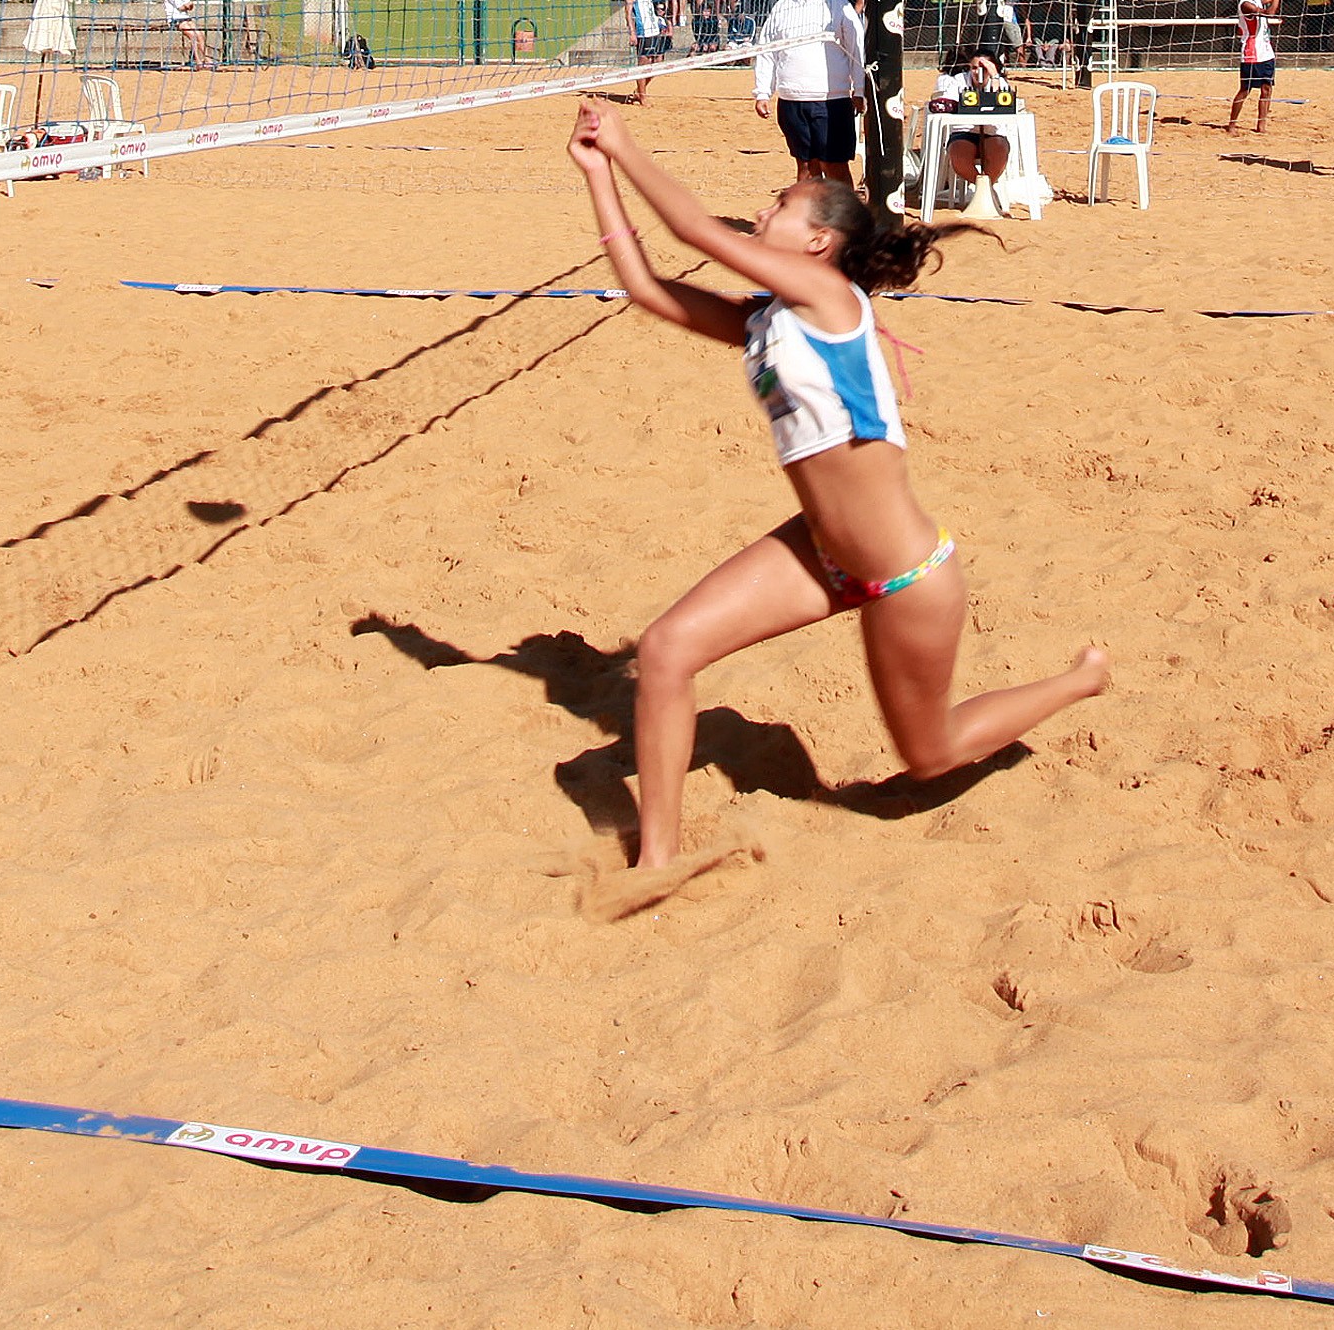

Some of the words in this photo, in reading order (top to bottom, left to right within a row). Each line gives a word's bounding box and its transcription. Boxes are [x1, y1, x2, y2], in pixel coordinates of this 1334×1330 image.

[963, 91, 978, 106] 3
[997, 91, 1012, 107] 0
[262, 124, 284, 136] amvp
[195, 131, 219, 145] amvp
[119, 142, 147, 156] amvp
[32, 152, 63, 168] amvp
[225, 1133, 351, 1161] amvp
